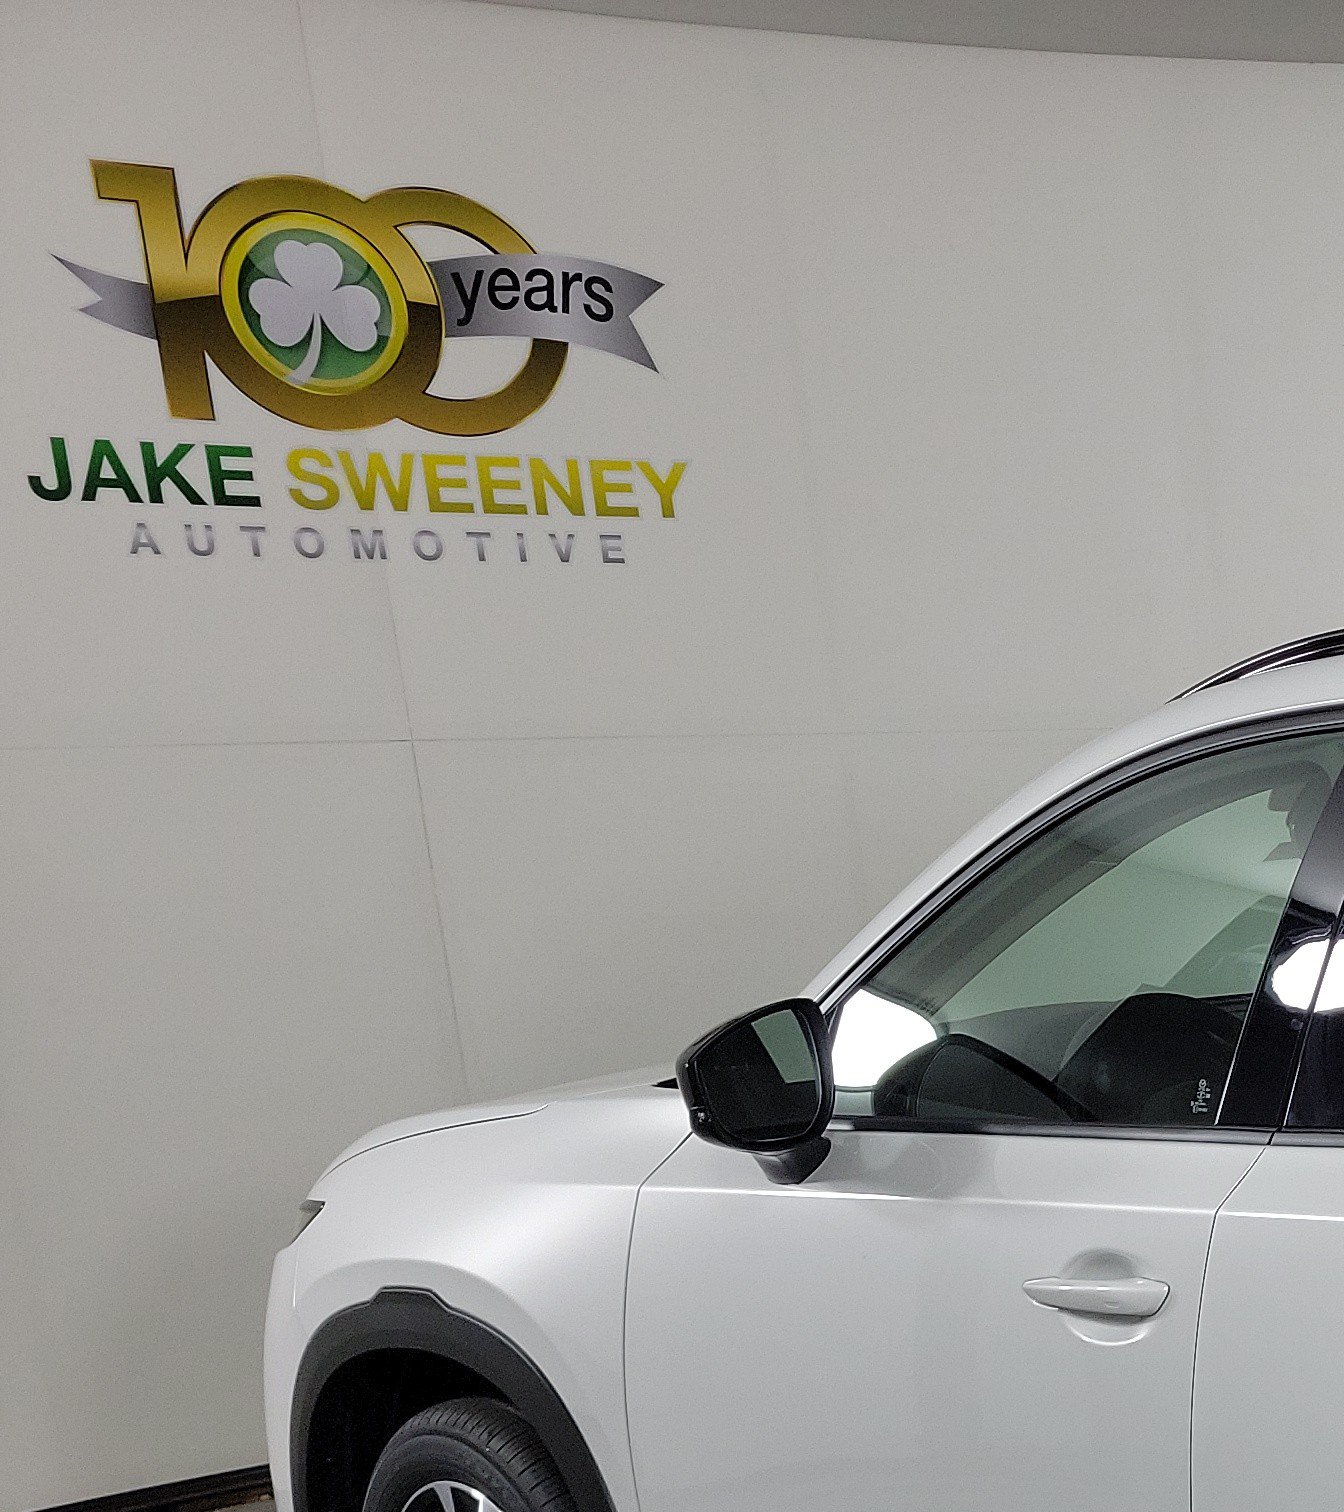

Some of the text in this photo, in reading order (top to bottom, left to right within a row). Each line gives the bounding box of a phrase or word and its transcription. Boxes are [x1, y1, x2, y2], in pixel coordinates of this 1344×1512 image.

[89, 159, 616, 437] 100 years
[27, 436, 688, 519] JAKE SWEENEY
[129, 522, 626, 564] AUTOMOTIVE
